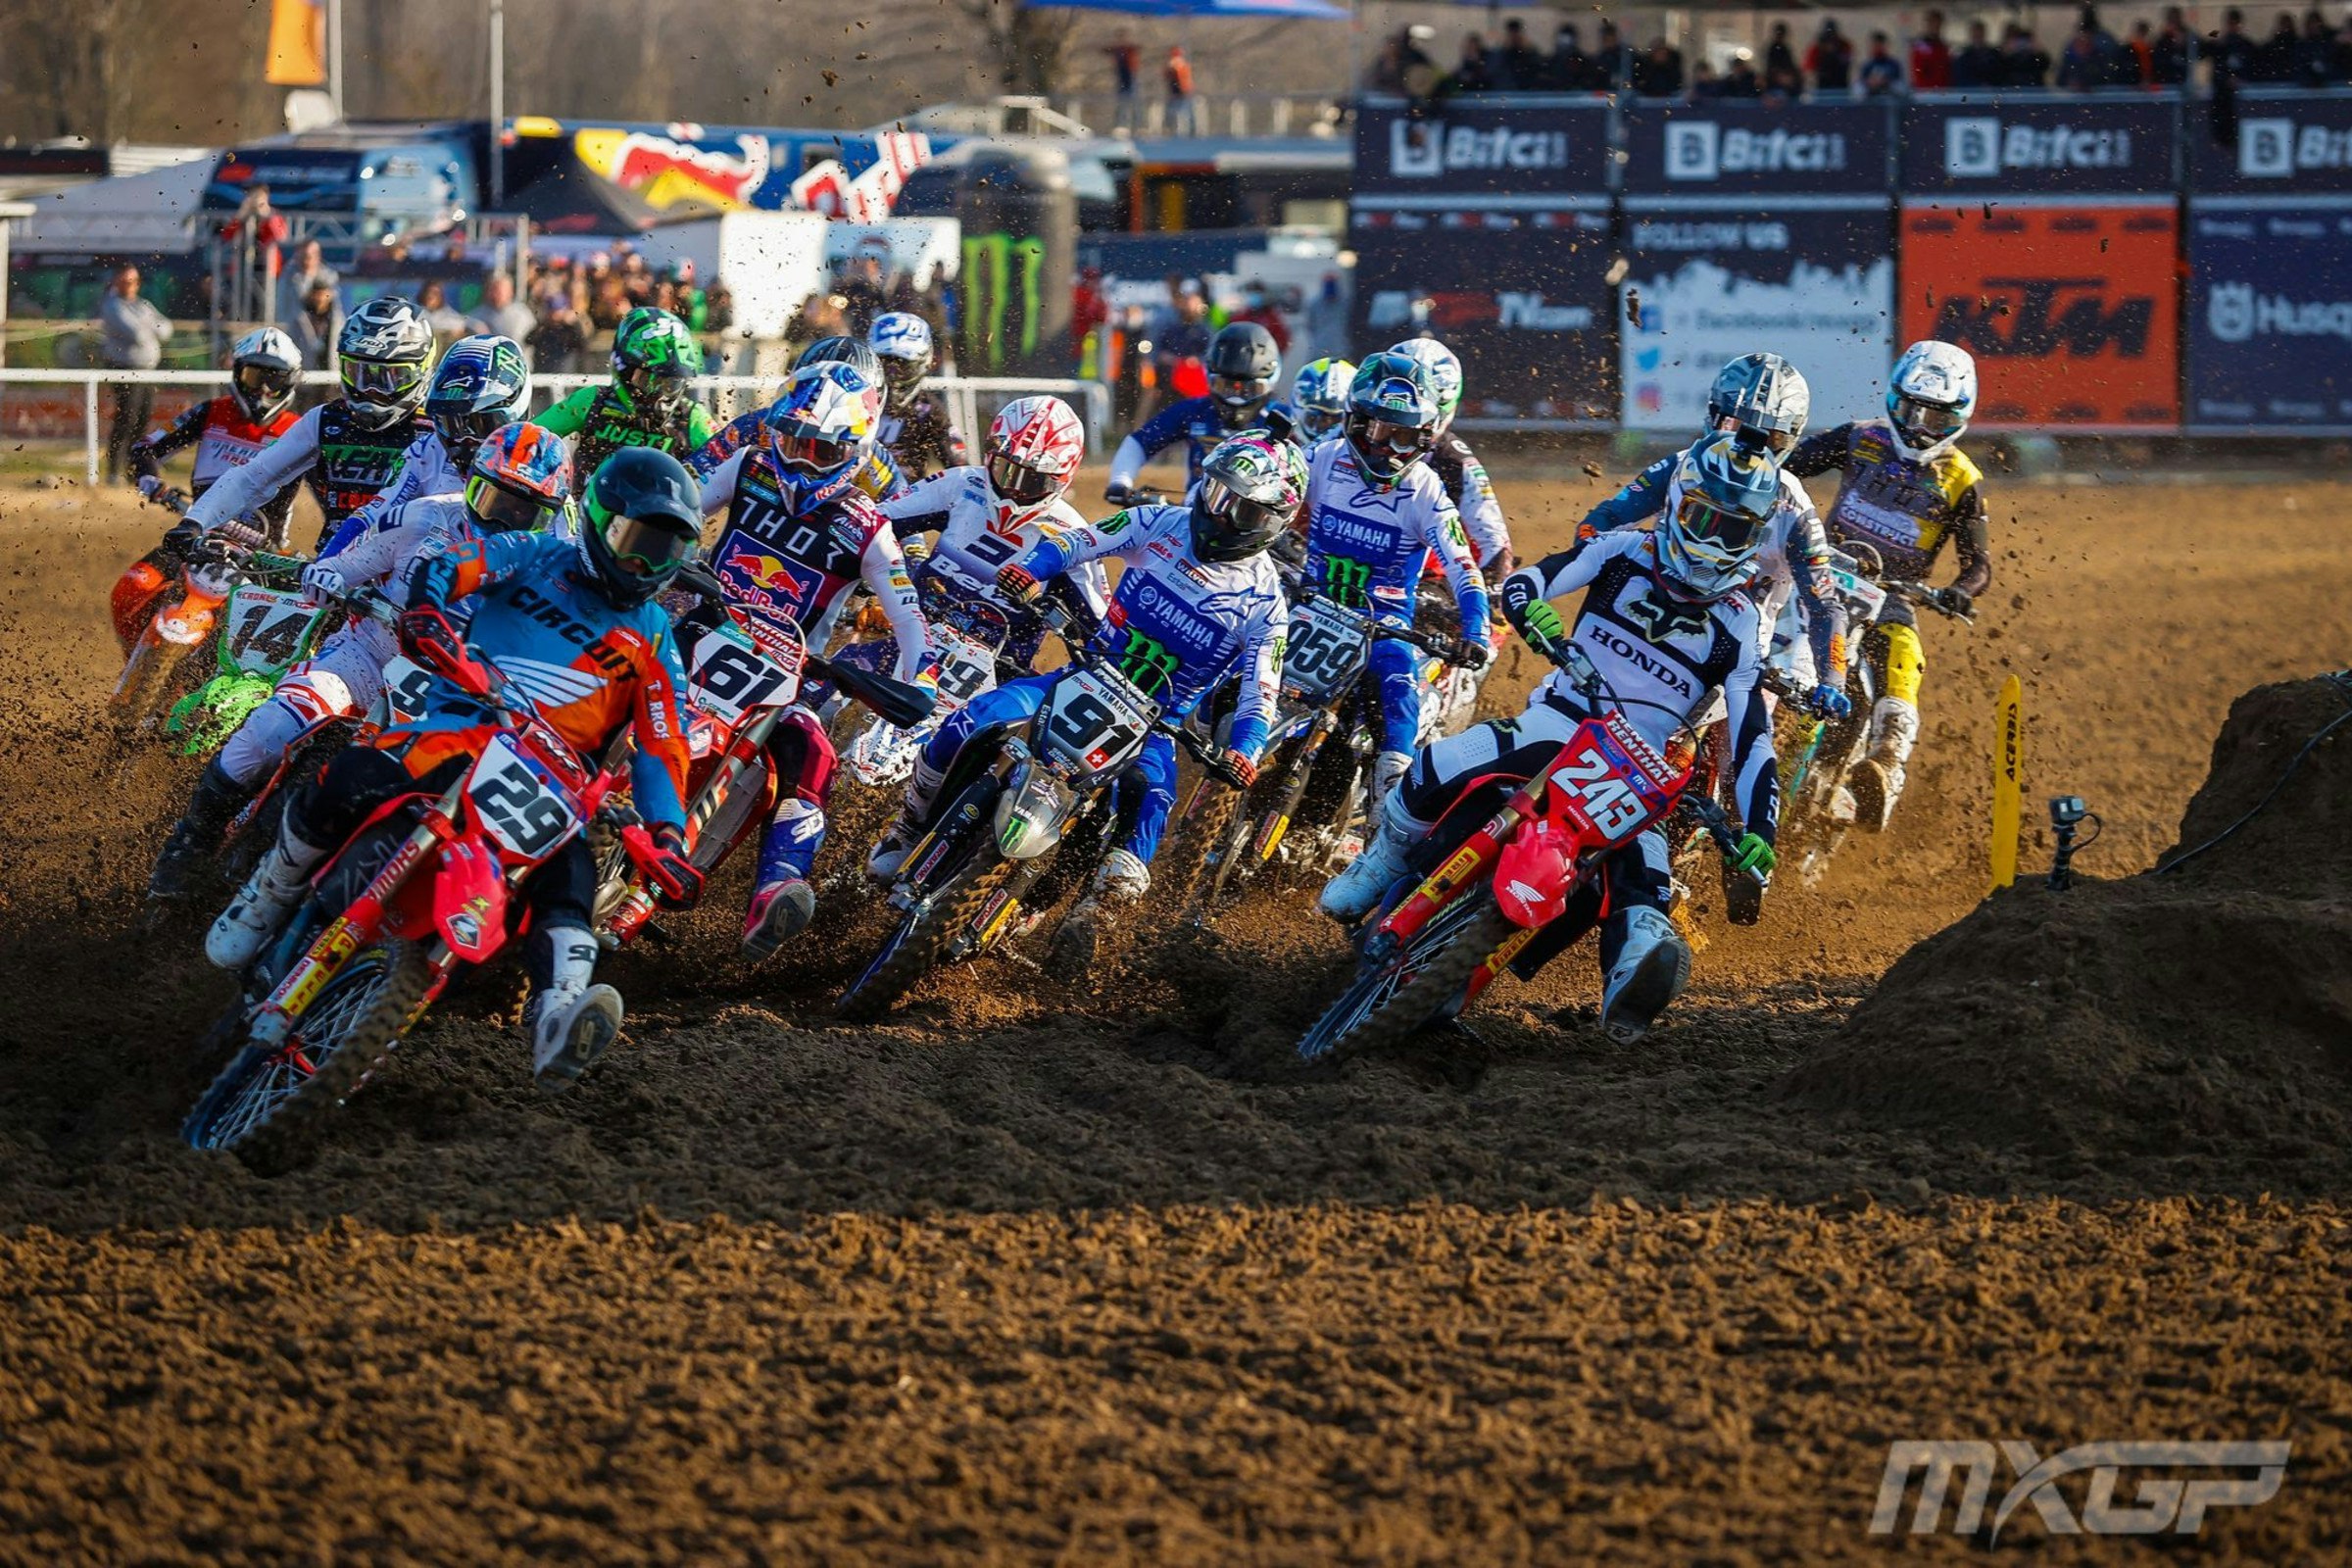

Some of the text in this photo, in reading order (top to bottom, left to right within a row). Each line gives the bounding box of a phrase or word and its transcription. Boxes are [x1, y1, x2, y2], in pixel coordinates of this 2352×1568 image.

[1632, 222, 1788, 250] FOLLOW US
[1934, 278, 2155, 357] KTM
[595, 423, 674, 453] JUST1
[1337, 519, 1392, 549] YAMAHA
[1155, 596, 1215, 649] YAMAHA
[1505, 582, 1528, 610] FOX
[232, 605, 314, 664] 14
[509, 587, 637, 682] CIRCUIT
[1590, 625, 1691, 700] HONDA
[690, 644, 788, 711] 61
[1099, 688, 1130, 717] YAMAHA
[1051, 693, 1138, 757] 91
[1608, 719, 1670, 787] RENTHAL
[2006, 703, 2018, 782] ACERBIS
[469, 761, 569, 855] 29
[1551, 749, 1648, 840] 243
[1568, 806, 1591, 831] HONDA
